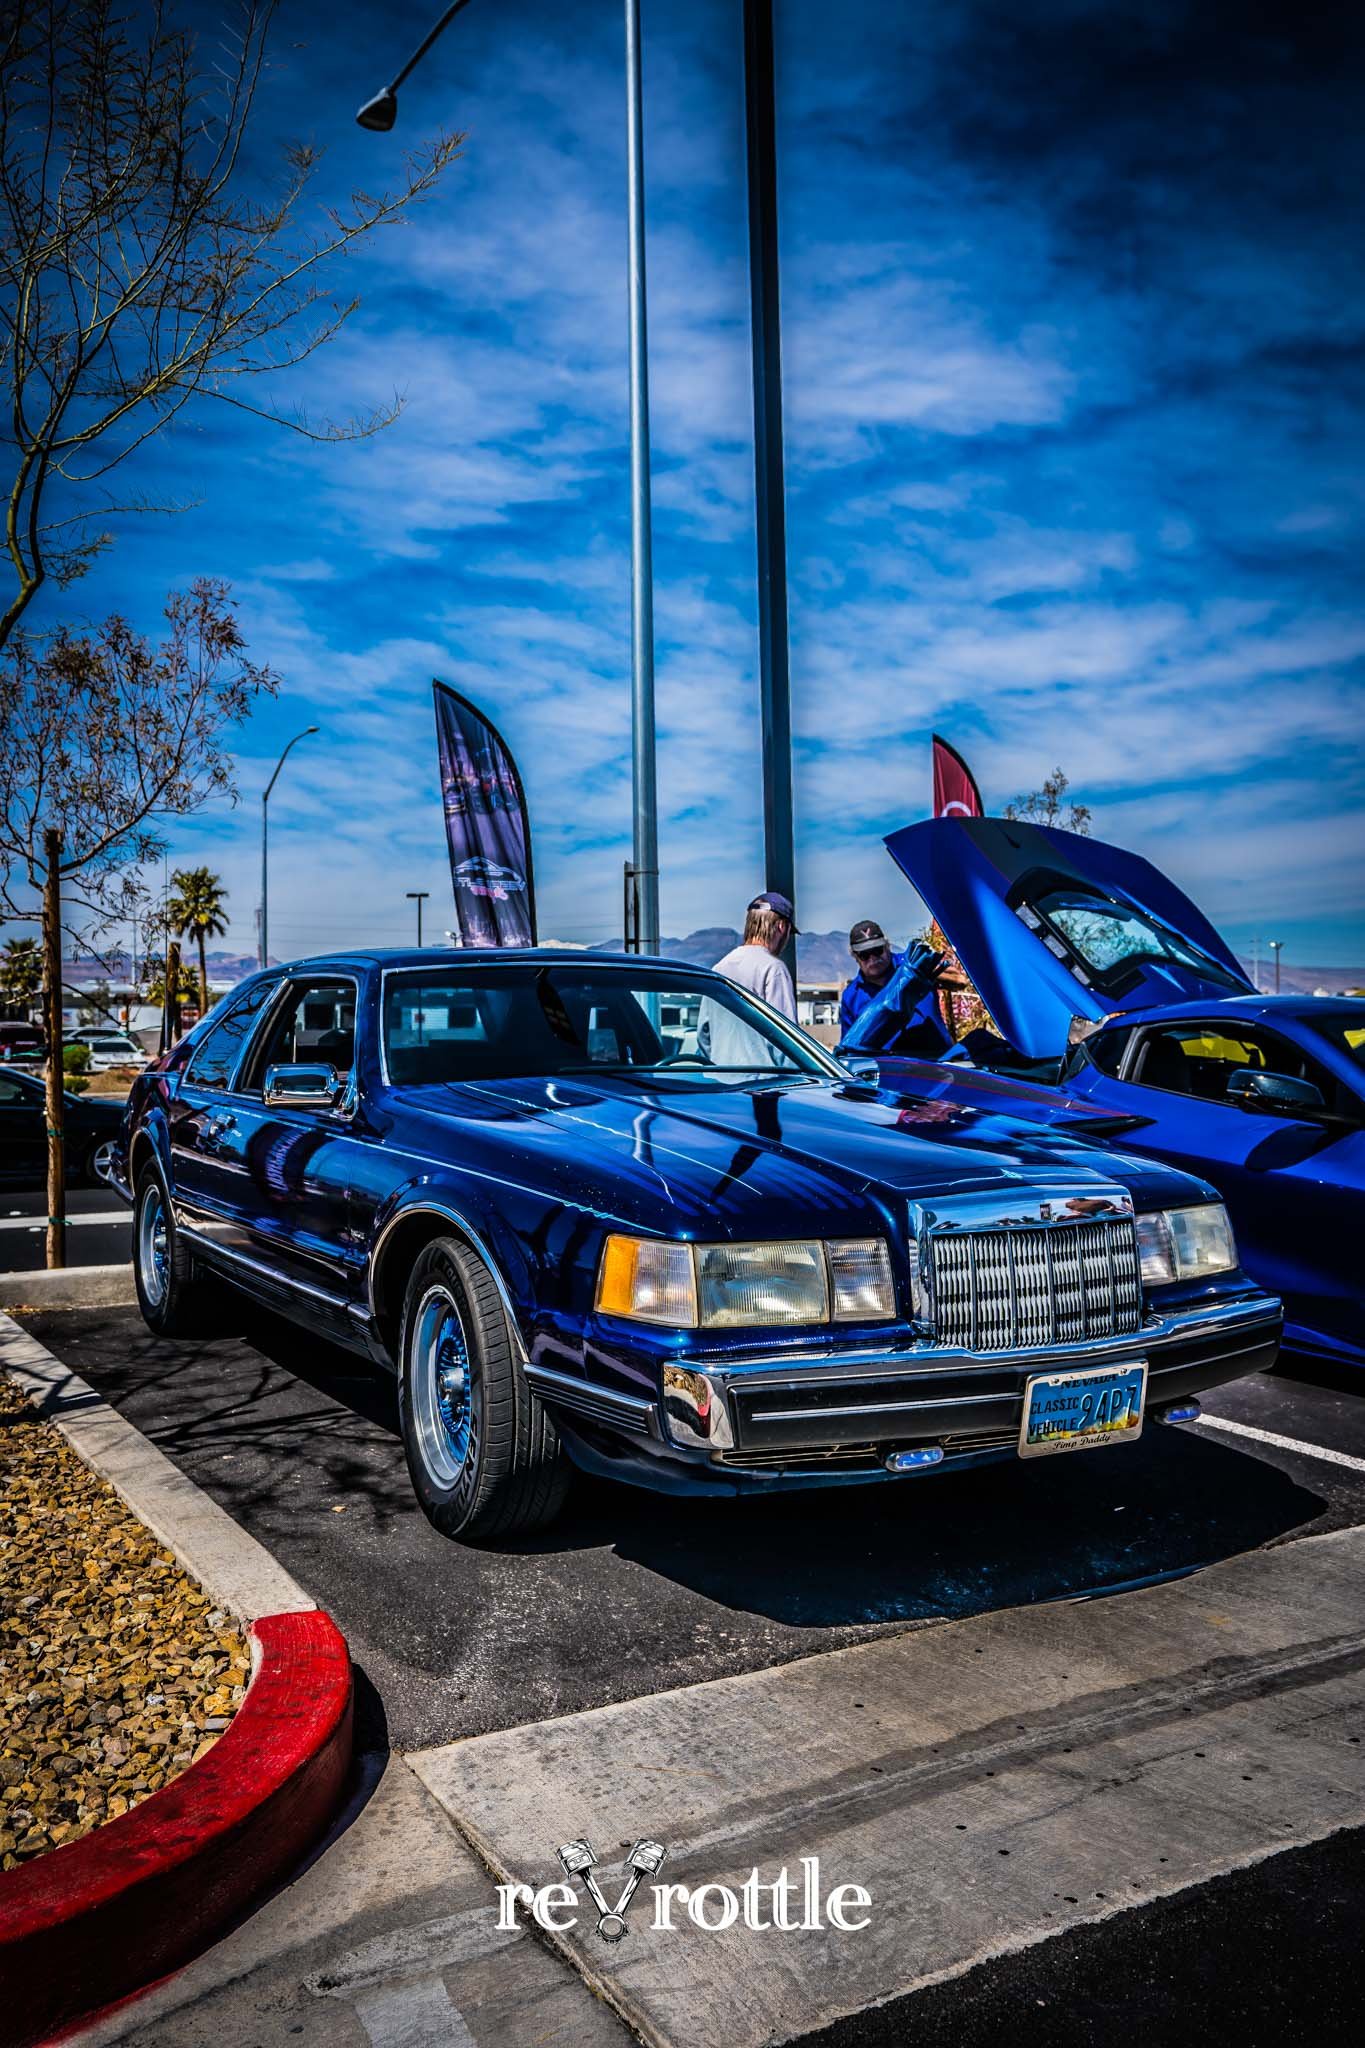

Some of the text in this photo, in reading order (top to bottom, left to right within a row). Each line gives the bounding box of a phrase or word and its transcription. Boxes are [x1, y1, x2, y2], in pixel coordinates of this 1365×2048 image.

[1030, 1396, 1080, 1415] CLASSIC
[1078, 1385, 1137, 1428] 94P7
[1029, 1418, 1079, 1435] VEHICLE
[1080, 1433, 1111, 1445] Daddy
